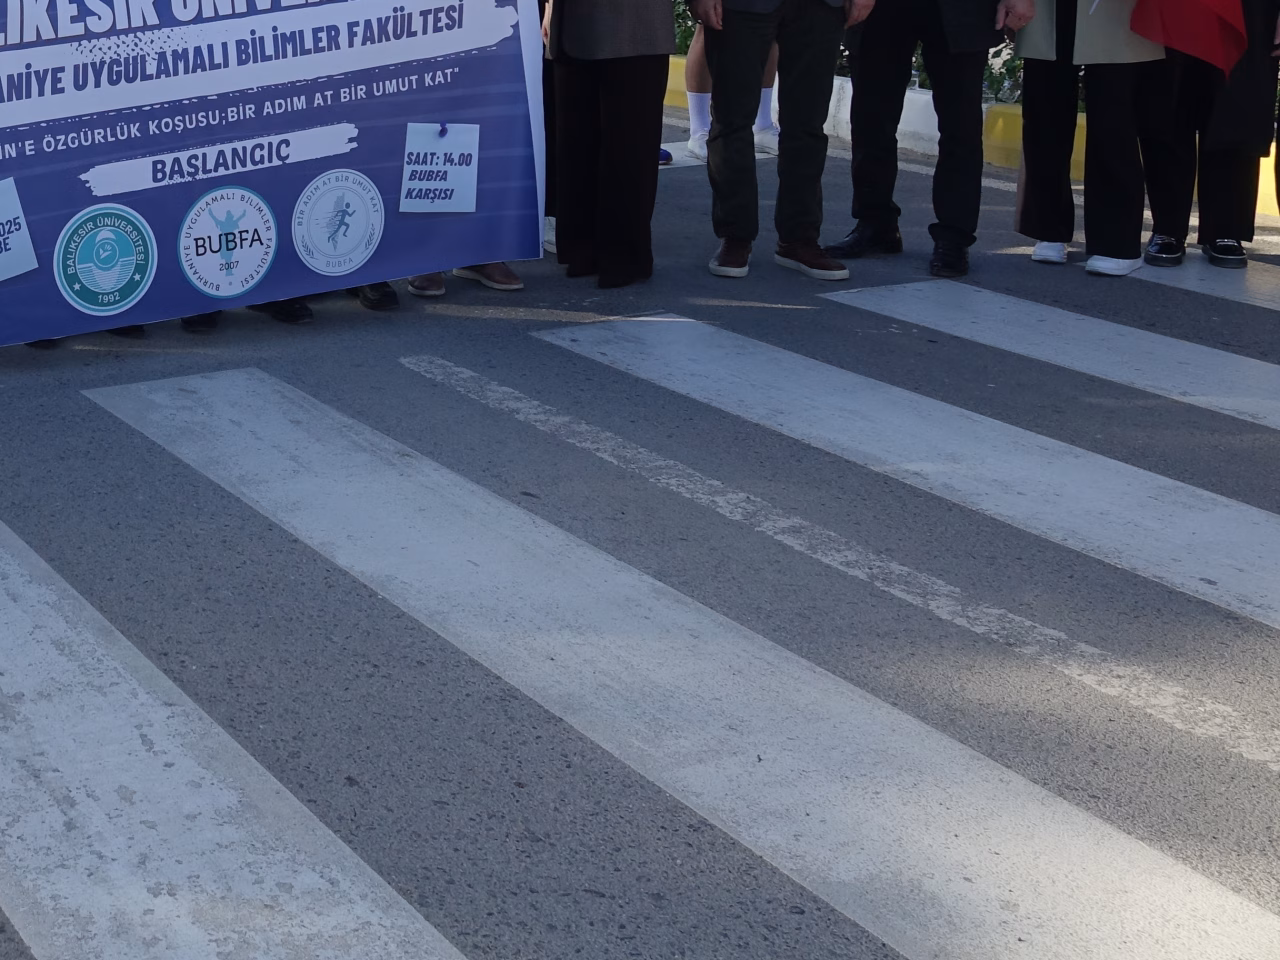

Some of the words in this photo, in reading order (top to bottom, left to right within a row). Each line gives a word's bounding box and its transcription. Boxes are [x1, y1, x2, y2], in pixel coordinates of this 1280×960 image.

[72, 42, 230, 92] UYGULAMALI
[235, 24, 342, 67] BİLİMLER
[42, 120, 141, 152] ÖZGÜRLÜK
[263, 93, 307, 117] ADIM
[313, 90, 334, 107] AT
[340, 82, 367, 102] BİR
[373, 74, 419, 97] UMUT
[151, 138, 291, 183] BAŞLANGIÇ
[406, 151, 440, 166] SAAT:
[442, 152, 473, 167] 14.00
[408, 169, 448, 182] BUBFA
[296, 209, 306, 227] BİR
[303, 185, 321, 207] ADIM
[322, 177, 332, 187] AT
[335, 173, 350, 183] BİR
[352, 178, 372, 195] UMUT
[369, 196, 379, 213] KAT
[404, 187, 455, 204] KARŞISI
[184, 192, 235, 239] UYGULAMALI
[66, 221, 96, 275] BALIKESİR
[96, 215, 146, 265] ÜNİVERSİTESİ
[193, 228, 264, 257] BUBFA
[219, 260, 240, 272] 2007
[325, 257, 354, 268] BUBFA
[97, 291, 121, 304] 1992
